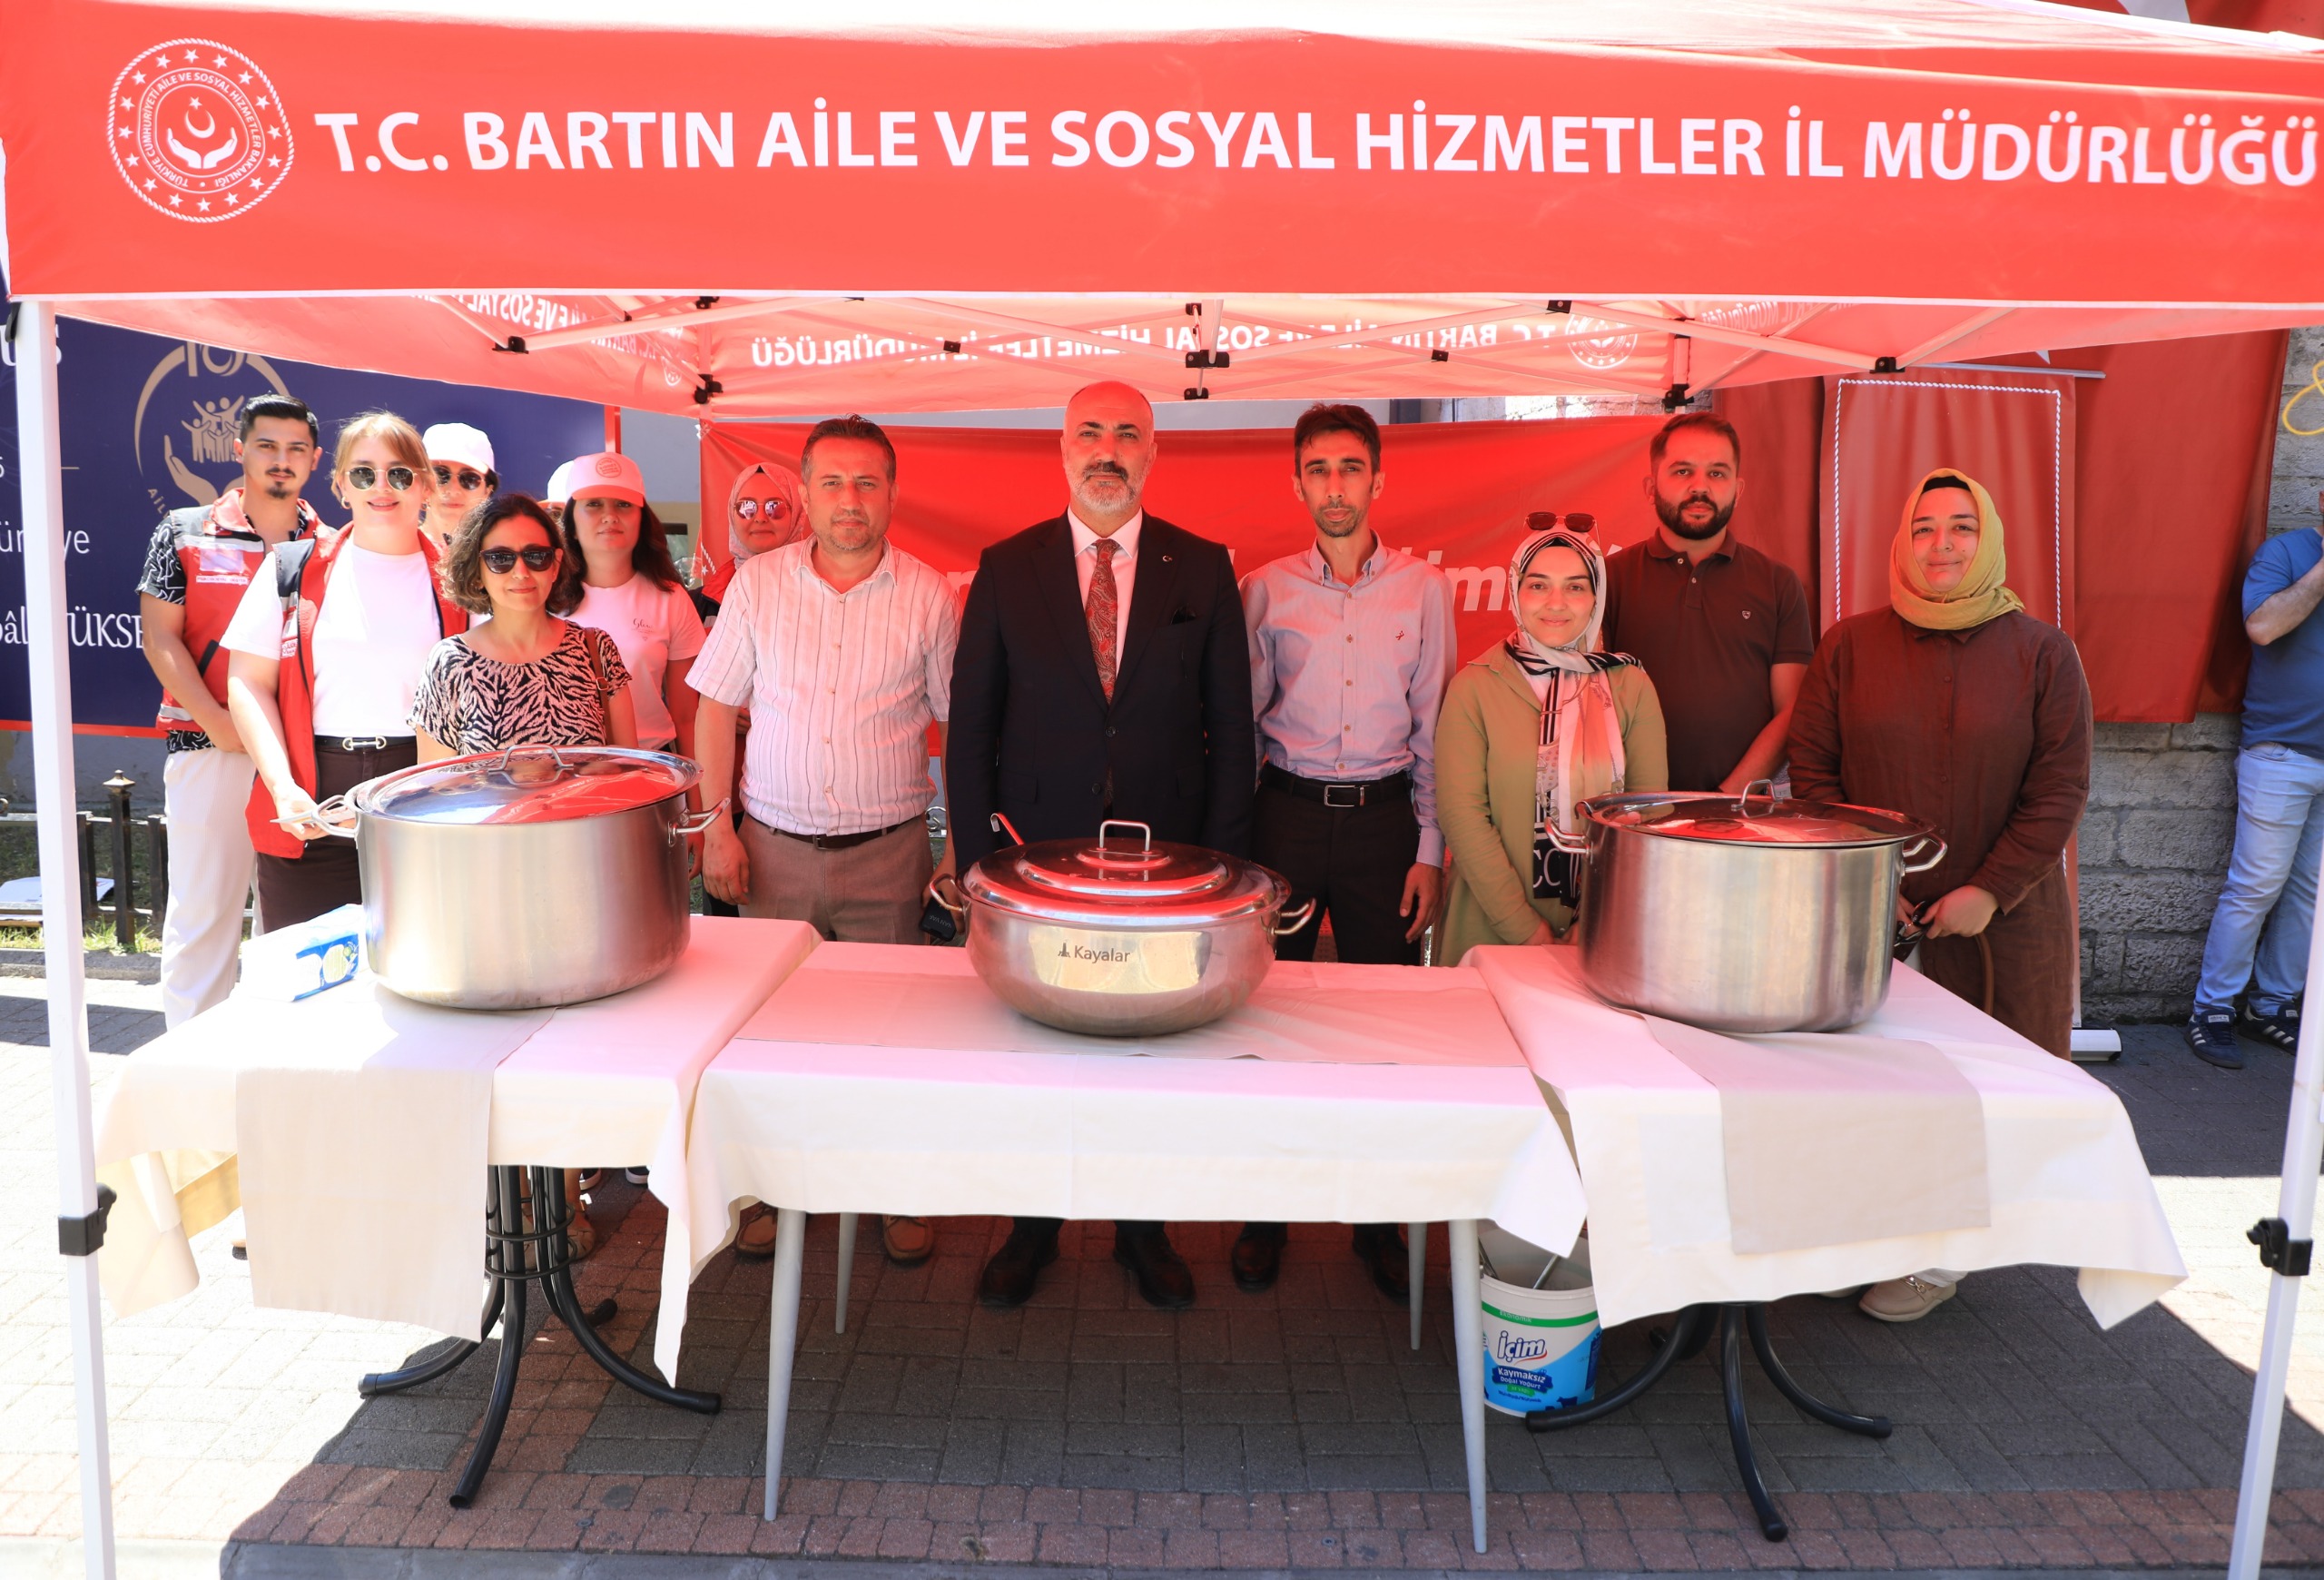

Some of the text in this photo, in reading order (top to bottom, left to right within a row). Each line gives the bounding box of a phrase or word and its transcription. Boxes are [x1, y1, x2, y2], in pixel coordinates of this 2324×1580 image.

[142, 72, 262, 188] TÜRKİYE CUMHURİYETİ AİLE VE SOSYAL HİZMETLER BAKANLIĞI
[315, 97, 2318, 187] T.C. BARTIN AİLE VE SOSYAL HİZMETLER İL MÜDÜRLÜĞÜ
[147, 488, 171, 518] AİL
[1074, 945, 1130, 963] Kayalar
[1497, 1330, 1545, 1362] İçim
[1498, 1367, 1546, 1384] Kaymaksız
[1500, 1376, 1541, 1389] Doğal Yoğurt
